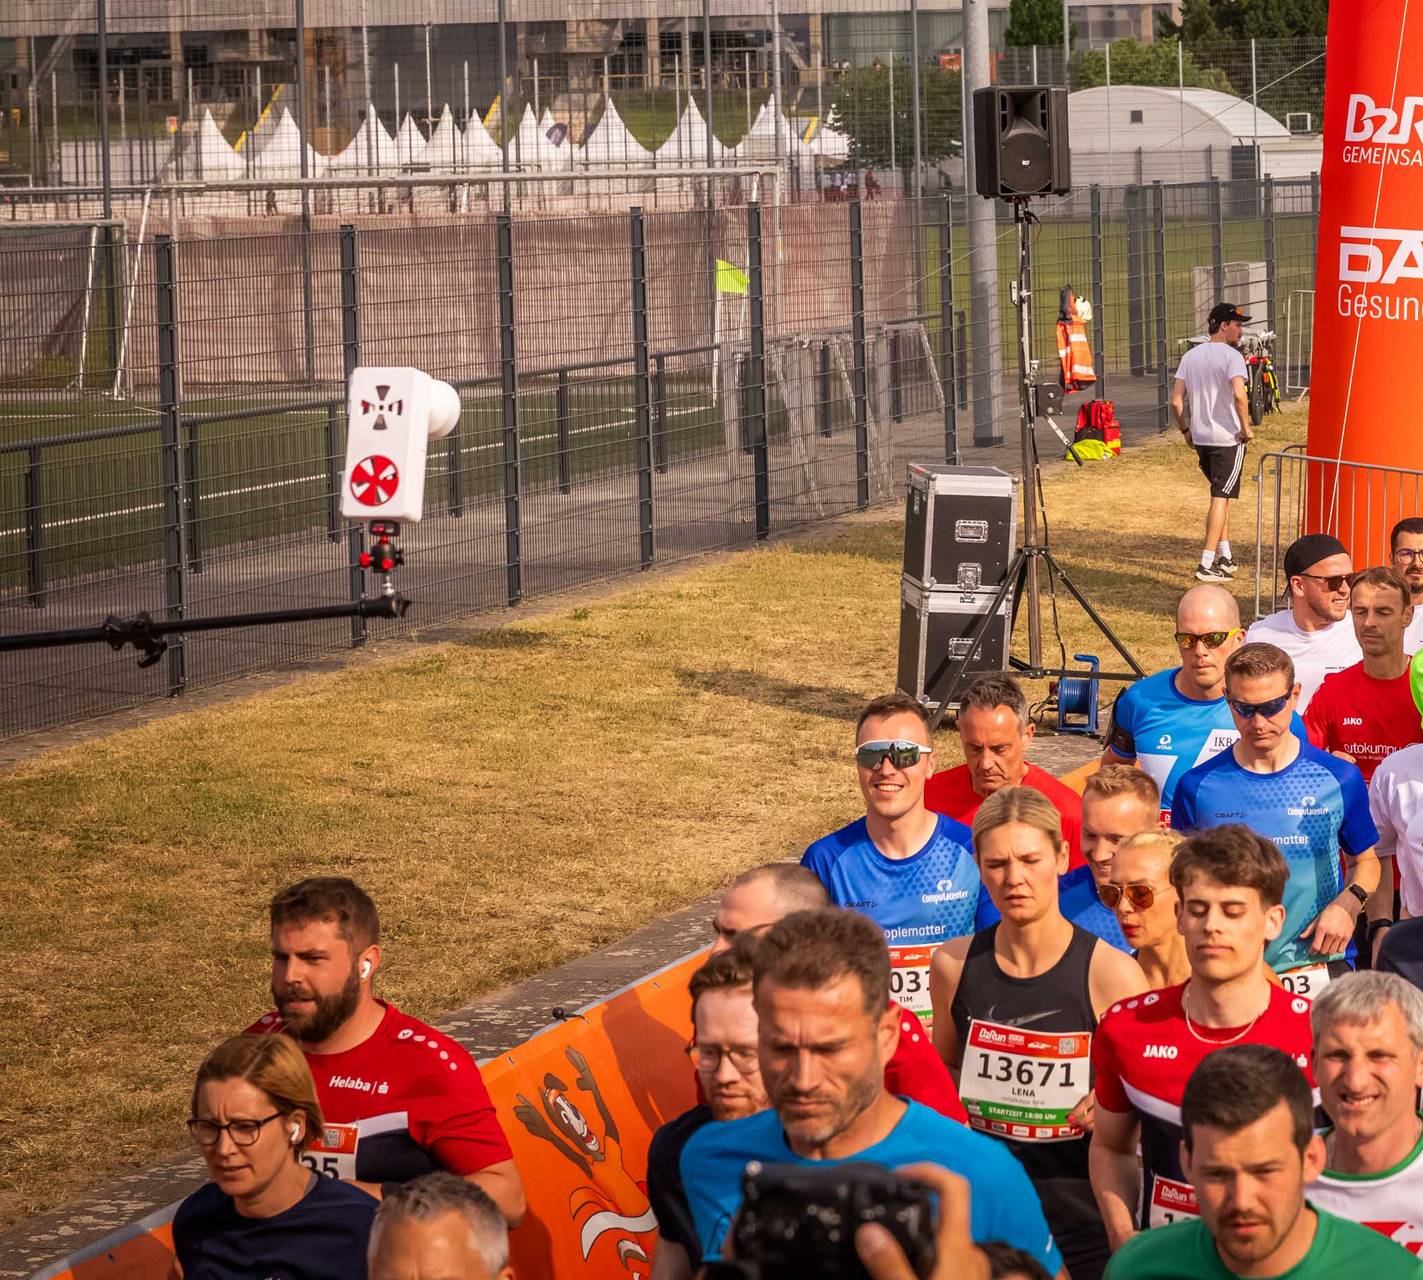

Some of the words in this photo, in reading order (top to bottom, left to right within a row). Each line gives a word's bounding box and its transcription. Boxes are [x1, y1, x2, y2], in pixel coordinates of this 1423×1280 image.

[1342, 717, 1363, 726] JAKO
[921, 889, 969, 905] Computacenter
[1142, 1044, 1179, 1060] JAKO
[977, 1052, 1075, 1088] 13671
[328, 1075, 372, 1092] Helaba
[1011, 1087, 1036, 1097] LENA
[988, 1106, 1023, 1118] STARTZEIT
[1024, 1111, 1043, 1120] 18:00
